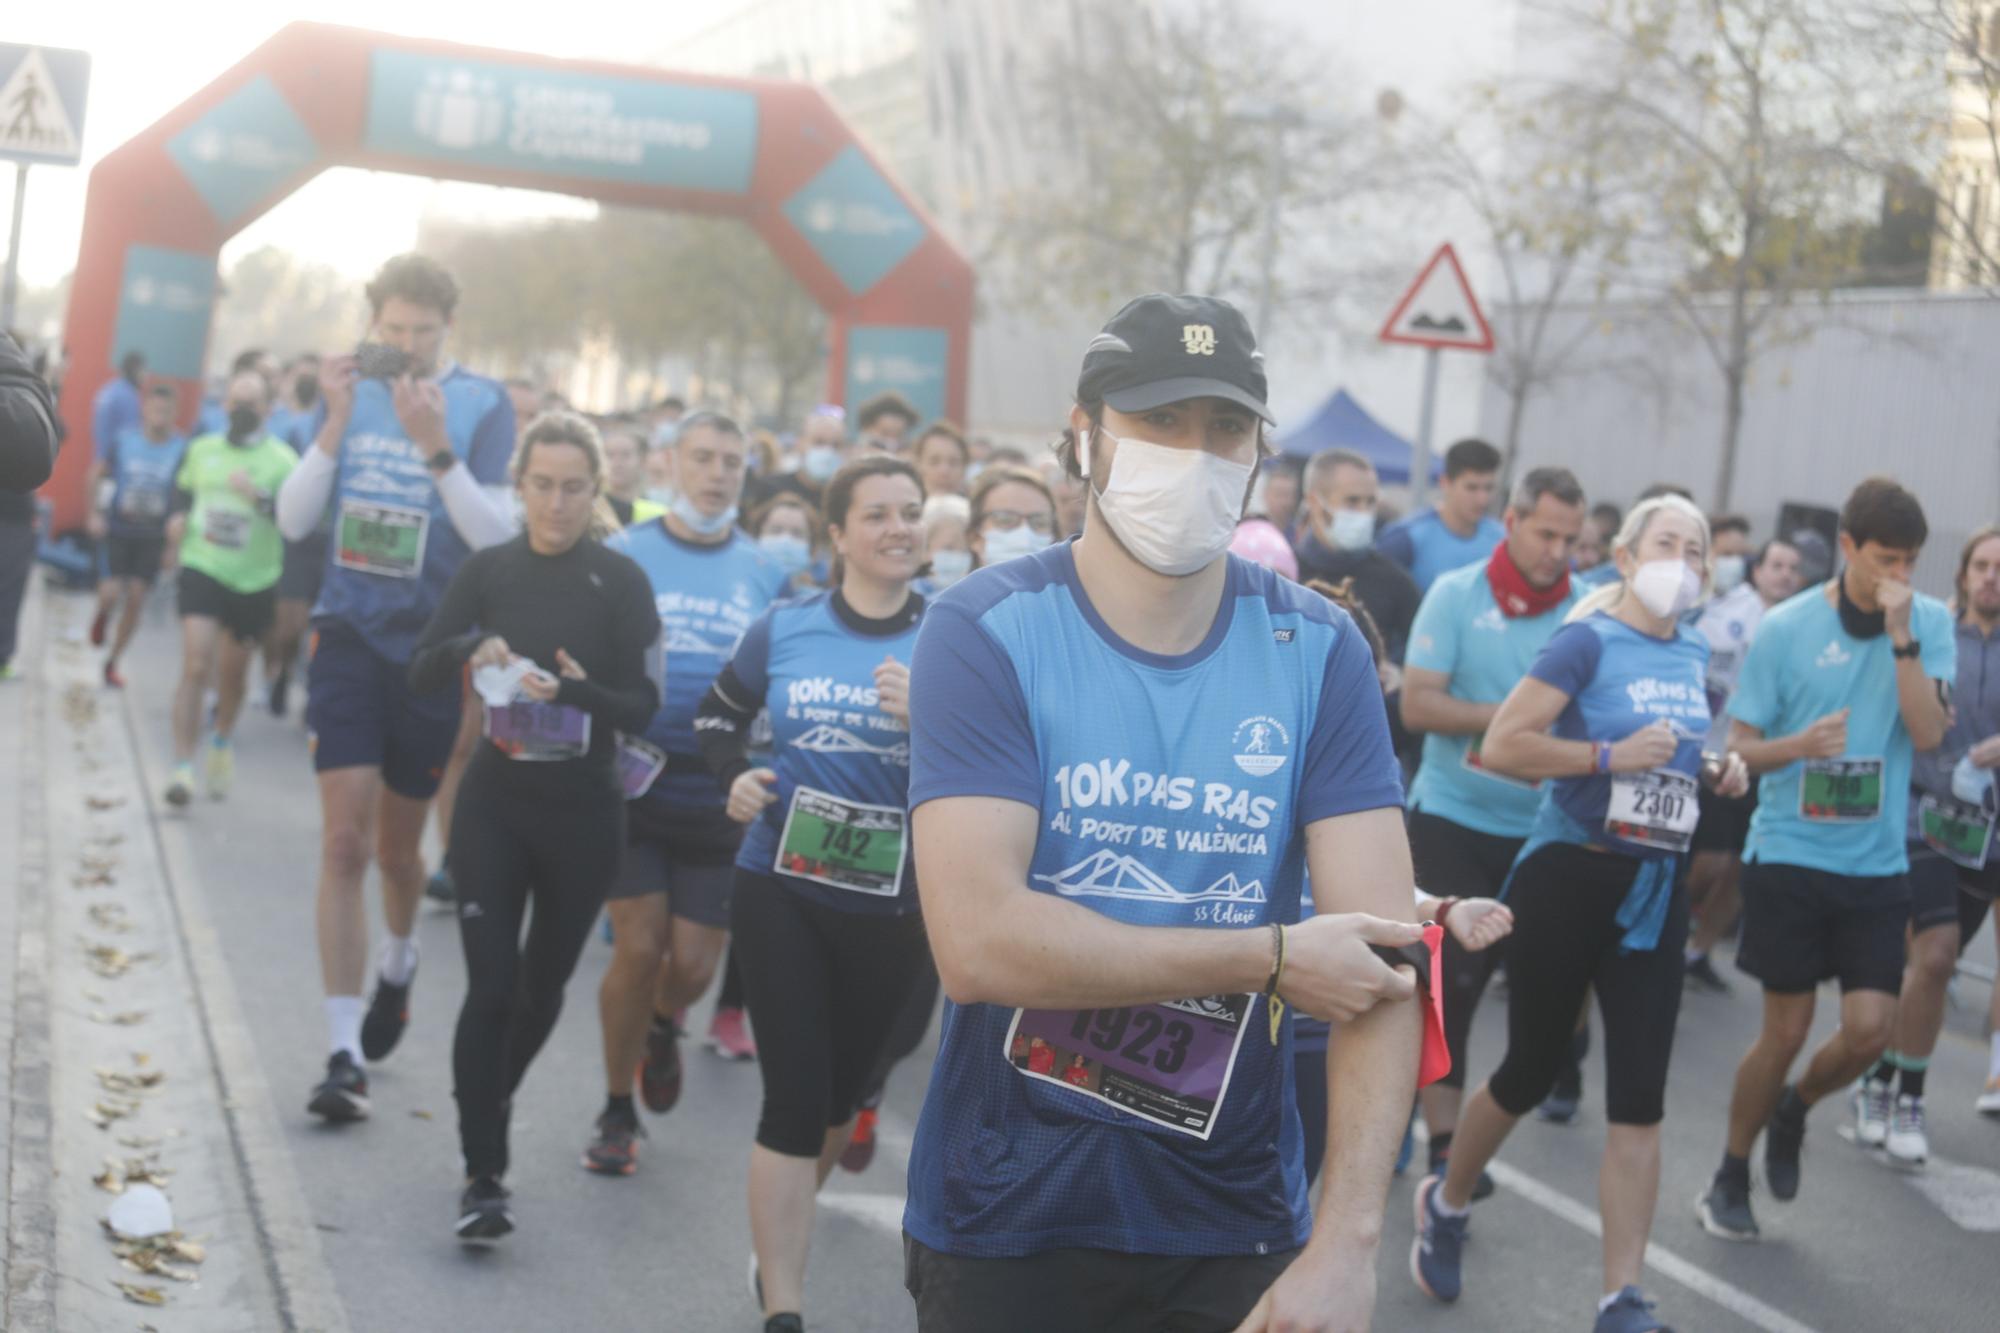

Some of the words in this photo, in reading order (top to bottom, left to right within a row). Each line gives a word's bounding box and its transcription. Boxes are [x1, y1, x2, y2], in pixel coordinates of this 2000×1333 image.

[787, 676, 834, 705] 10K
[833, 683, 880, 708] PAS
[1054, 758, 1131, 809] 10K
[1132, 771, 1196, 811] PAS
[1202, 782, 1278, 829] RAS
[1632, 787, 1686, 822] 2307
[819, 821, 873, 860] 742
[1051, 810, 1072, 835] AL
[1079, 816, 1138, 845] PORT
[1140, 825, 1169, 850] DE
[1175, 822, 1268, 856] VALÈNCIA
[1069, 1007, 1195, 1075] 1923
